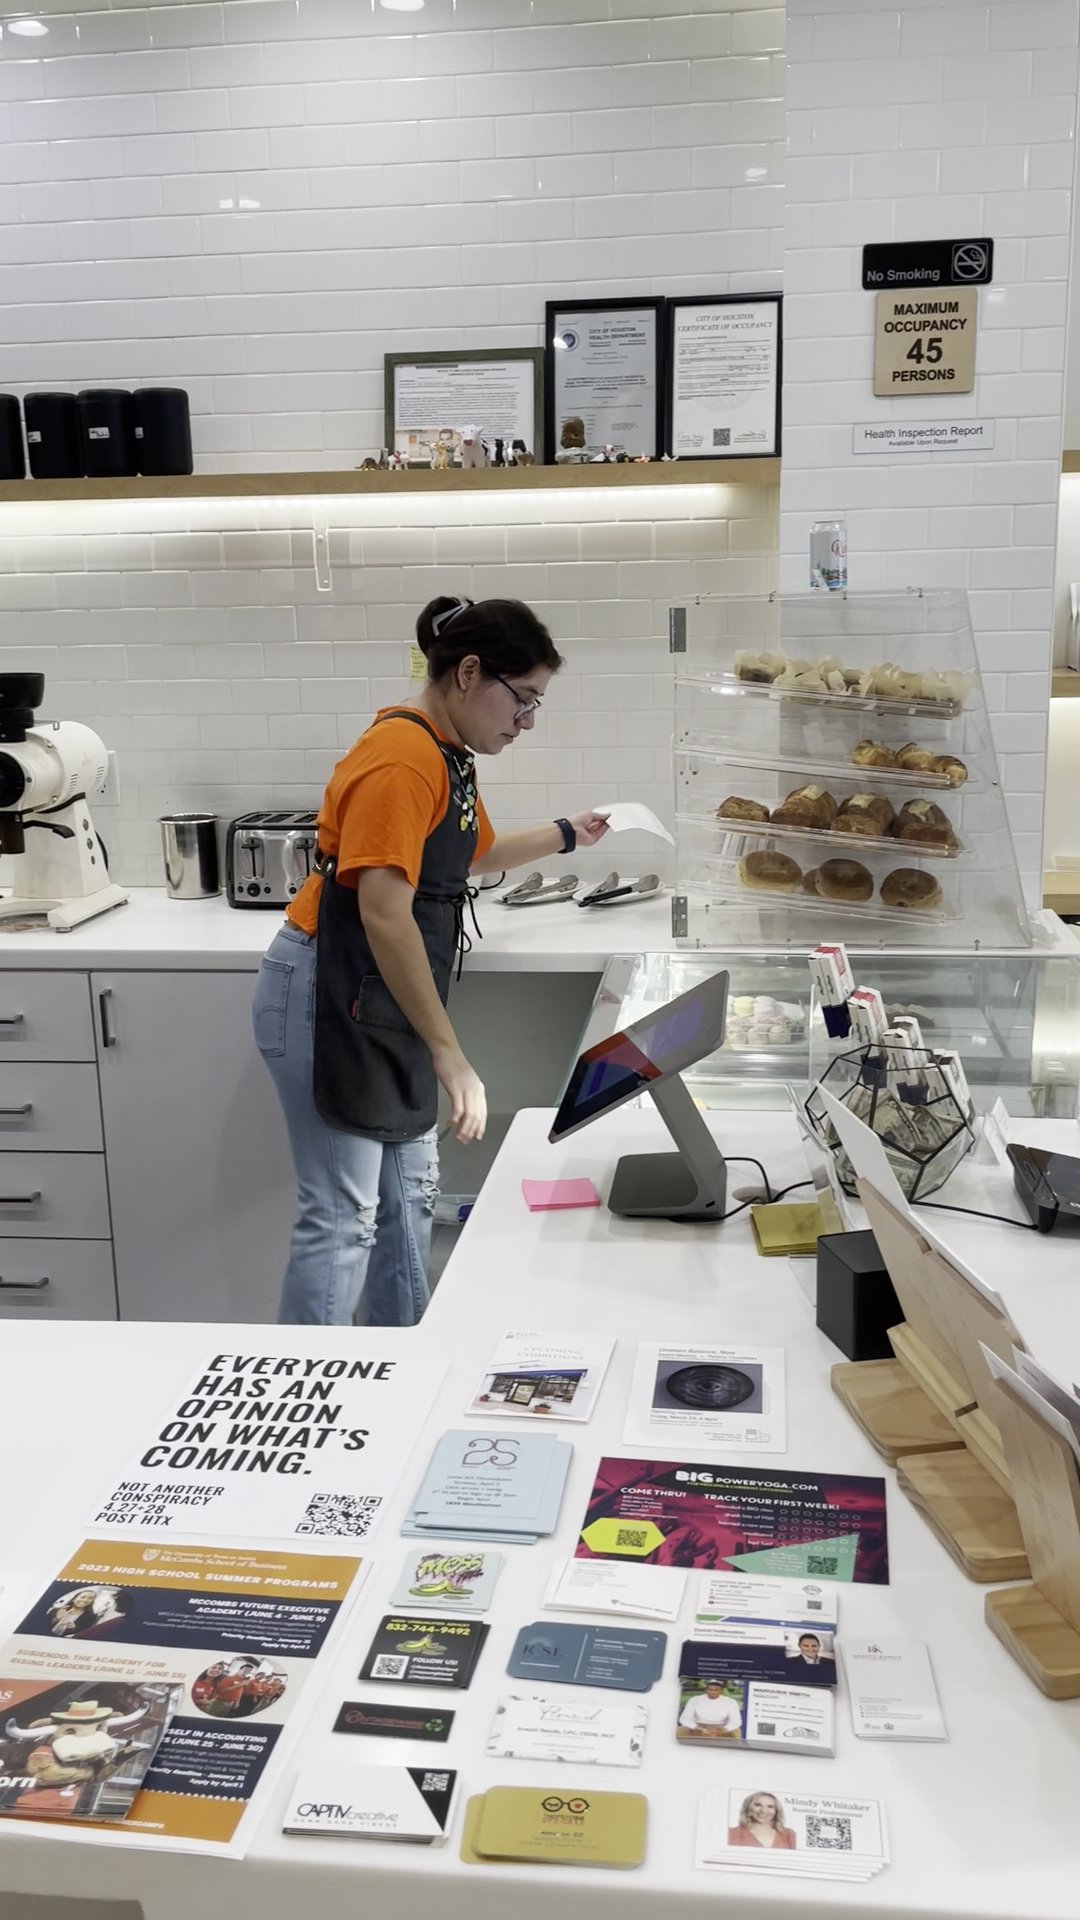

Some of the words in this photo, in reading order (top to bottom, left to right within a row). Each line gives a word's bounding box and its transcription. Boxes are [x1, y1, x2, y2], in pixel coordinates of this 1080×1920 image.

[867, 271, 884, 282] No
[886, 268, 940, 281] Smoking
[894, 302, 959, 316] MAXIMUM
[884, 319, 968, 333] OCCUPANCY
[906, 337, 943, 364] 45
[892, 369, 955, 382] PERSONS
[864, 429, 896, 440] Health
[898, 428, 948, 440] Inspection
[950, 426, 983, 437] Report
[206, 1354, 397, 1380] EVERYONE
[191, 1375, 272, 1398] HAS
[280, 1380, 335, 1400] AN
[176, 1399, 343, 1424] OPINION
[158, 1422, 217, 1444] ON
[226, 1424, 370, 1450] WHAT'S
[140, 1445, 313, 1475] COMING.
[675, 1470, 714, 1483] BIG
[716, 1478, 818, 1492] POWERYOGA.COM
[118, 1482, 151, 1492] NOT
[152, 1484, 225, 1496] ANOTHER
[110, 1492, 212, 1506] CONSPIRACY
[620, 1488, 652, 1496] COME
[704, 1494, 739, 1502] TRACK
[740, 1496, 772, 1504] YOUR
[774, 1499, 802, 1507] FIRST
[804, 1502, 840, 1510] WEEK!
[94, 1512, 138, 1524] POST
[140, 1514, 174, 1526] HTX
[160, 1556, 204, 1564] McCombs
[248, 1562, 287, 1570] Business
[77, 1564, 111, 1572] 2023
[112, 1566, 146, 1576] HIGH
[148, 1569, 201, 1580] SCHOOL
[205, 1574, 262, 1584] SUMMER
[264, 1578, 338, 1588] PROGRAMS
[189, 1598, 238, 1608] MCCOMBS
[240, 1602, 276, 1610] FUTURE
[277, 1604, 331, 1614] EXECUTIVE
[196, 1607, 243, 1616] ACADEMY
[244, 1610, 274, 1618] (JUNE
[288, 1614, 314, 1622] JUNE
[316, 1615, 326, 1623] 9)
[386, 1623, 470, 1636] 832-744-9492
[16, 1649, 70, 1660] SUBIENDO:
[94, 1656, 144, 1666] ACADEMY
[10, 1658, 44, 1666] RISING
[46, 1661, 92, 1671] LEADERS
[93, 1664, 123, 1674] (JUNE
[142, 1670, 169, 1678] JUNE
[166, 1728, 192, 1736] SELF
[192, 1730, 204, 1738] IN
[204, 1732, 268, 1743] ACCOUNTING
[172, 1737, 201, 1746] (JUNE
[188, 1778, 211, 1786] Apply
[208, 1772, 236, 1780] January
[784, 1797, 818, 1808] Mindy
[821, 1800, 870, 1811] Whitaker
